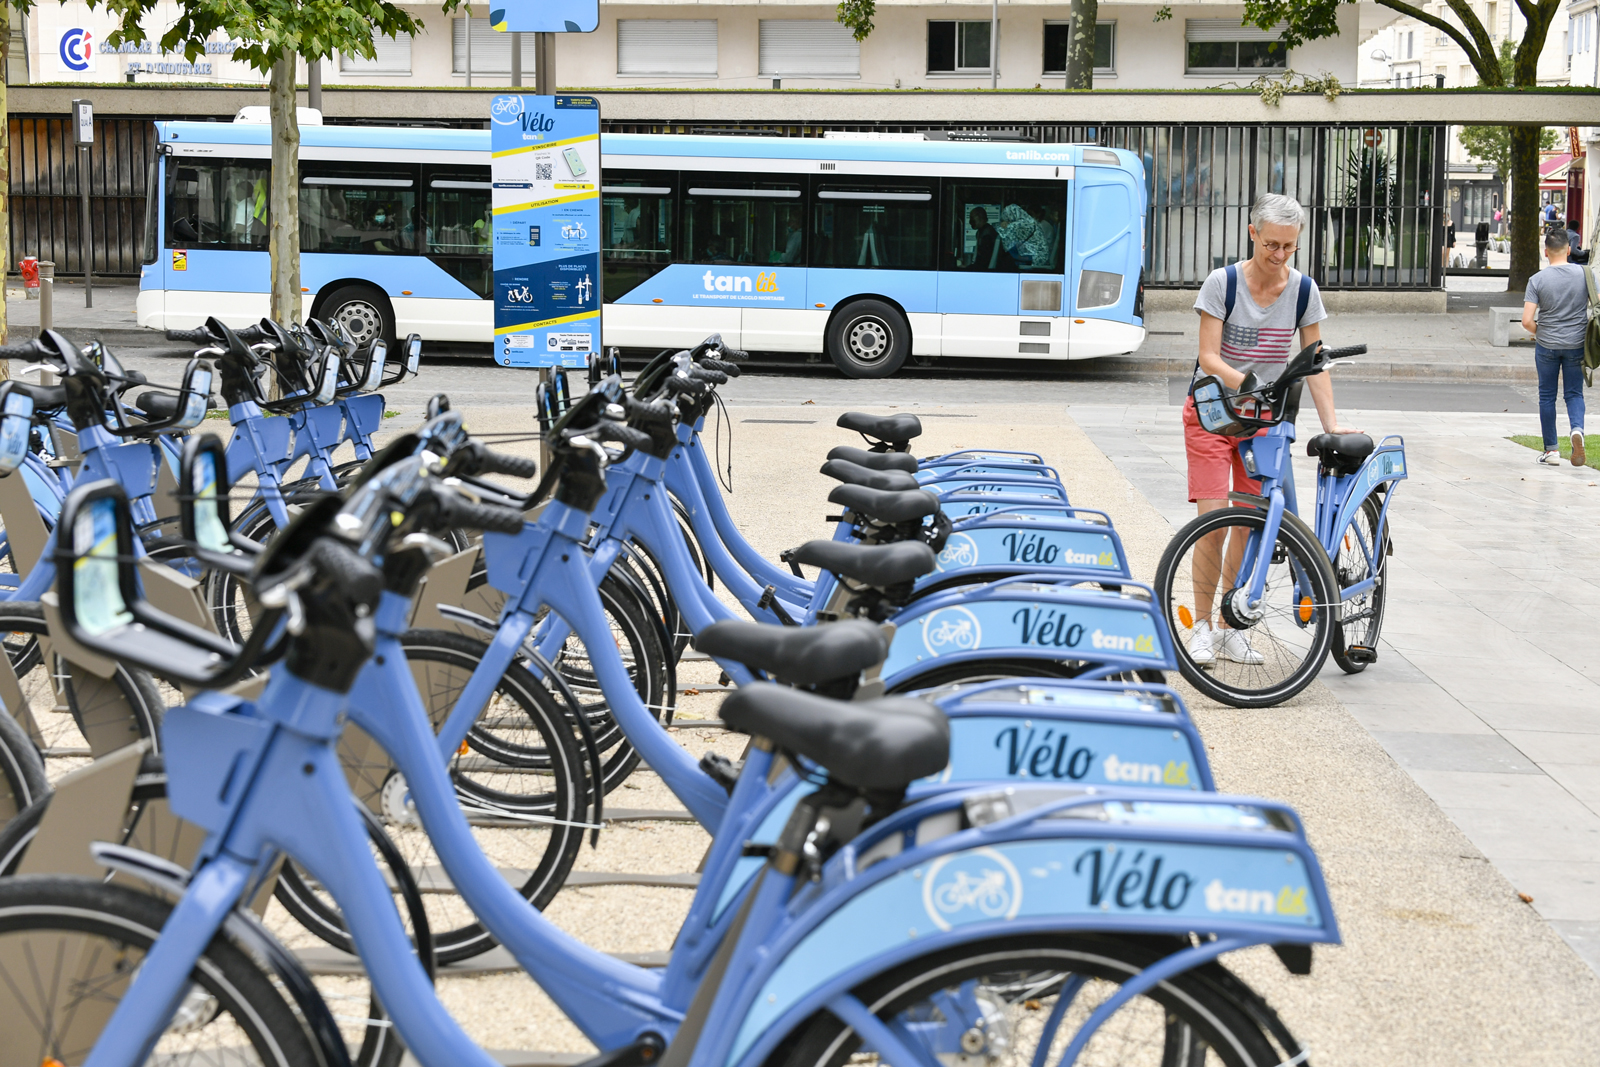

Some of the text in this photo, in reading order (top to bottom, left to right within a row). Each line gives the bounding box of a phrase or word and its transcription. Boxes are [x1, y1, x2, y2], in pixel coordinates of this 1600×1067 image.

[146, 62, 212, 75] D'INDUSTRIE
[517, 112, 556, 132] Vélo
[1006, 150, 1070, 161] tanlib.com
[530, 199, 559, 208] UTILISATION
[533, 320, 557, 328] CONTACTS
[1002, 532, 1060, 564] Vélo
[1013, 607, 1087, 648] Vélo
[995, 726, 1097, 780] Vélo
[1073, 848, 1198, 912] Vélo
